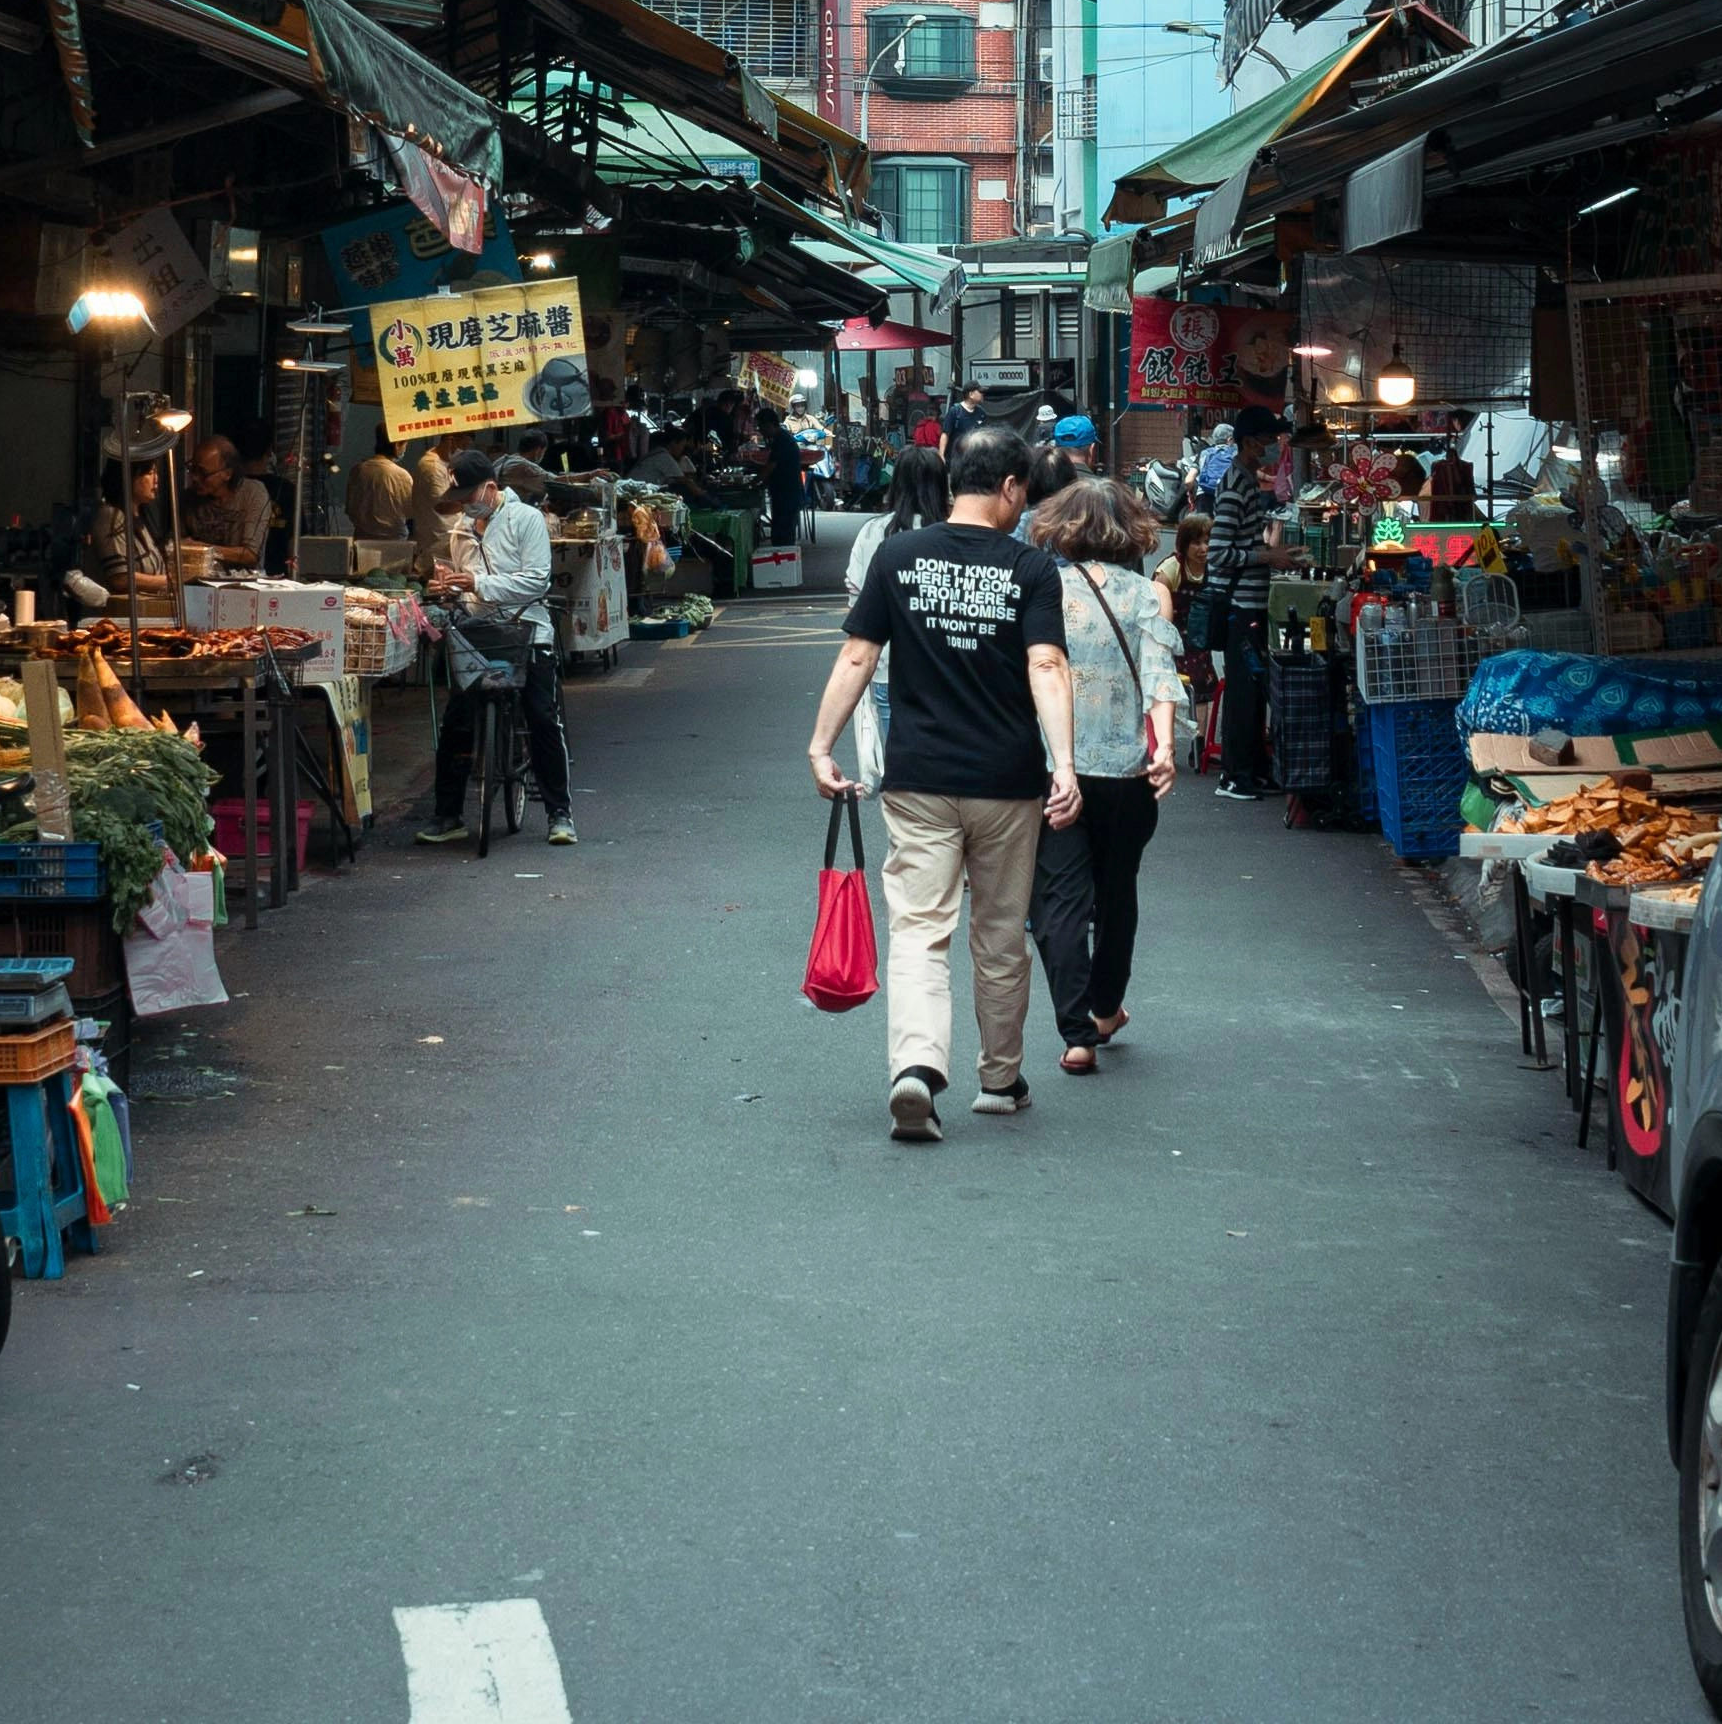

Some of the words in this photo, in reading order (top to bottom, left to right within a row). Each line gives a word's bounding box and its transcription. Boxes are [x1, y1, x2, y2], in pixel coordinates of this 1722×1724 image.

[824, 9, 835, 114] SHISEIDO
[426, 304, 574, 351] 現磨芝麻醬
[389, 317, 417, 369] 小萬
[1137, 346, 1245, 387] 餛飩王
[411, 382, 500, 413] 養生極品
[897, 570, 952, 587] WHERE
[954, 576, 975, 591] I'M
[978, 578, 1022, 599] GOING
[915, 557, 962, 577] DON'T
[964, 564, 1014, 582] KNOW
[909, 597, 939, 612] BUT
[940, 600, 946, 613] I
[949, 601, 1017, 622] PROMISE
[918, 584, 961, 601] FROM
[964, 589, 1006, 607] HERE
[926, 616, 938, 629] IT
[938, 618, 976, 633] WONT
[978, 622, 997, 636] BE
